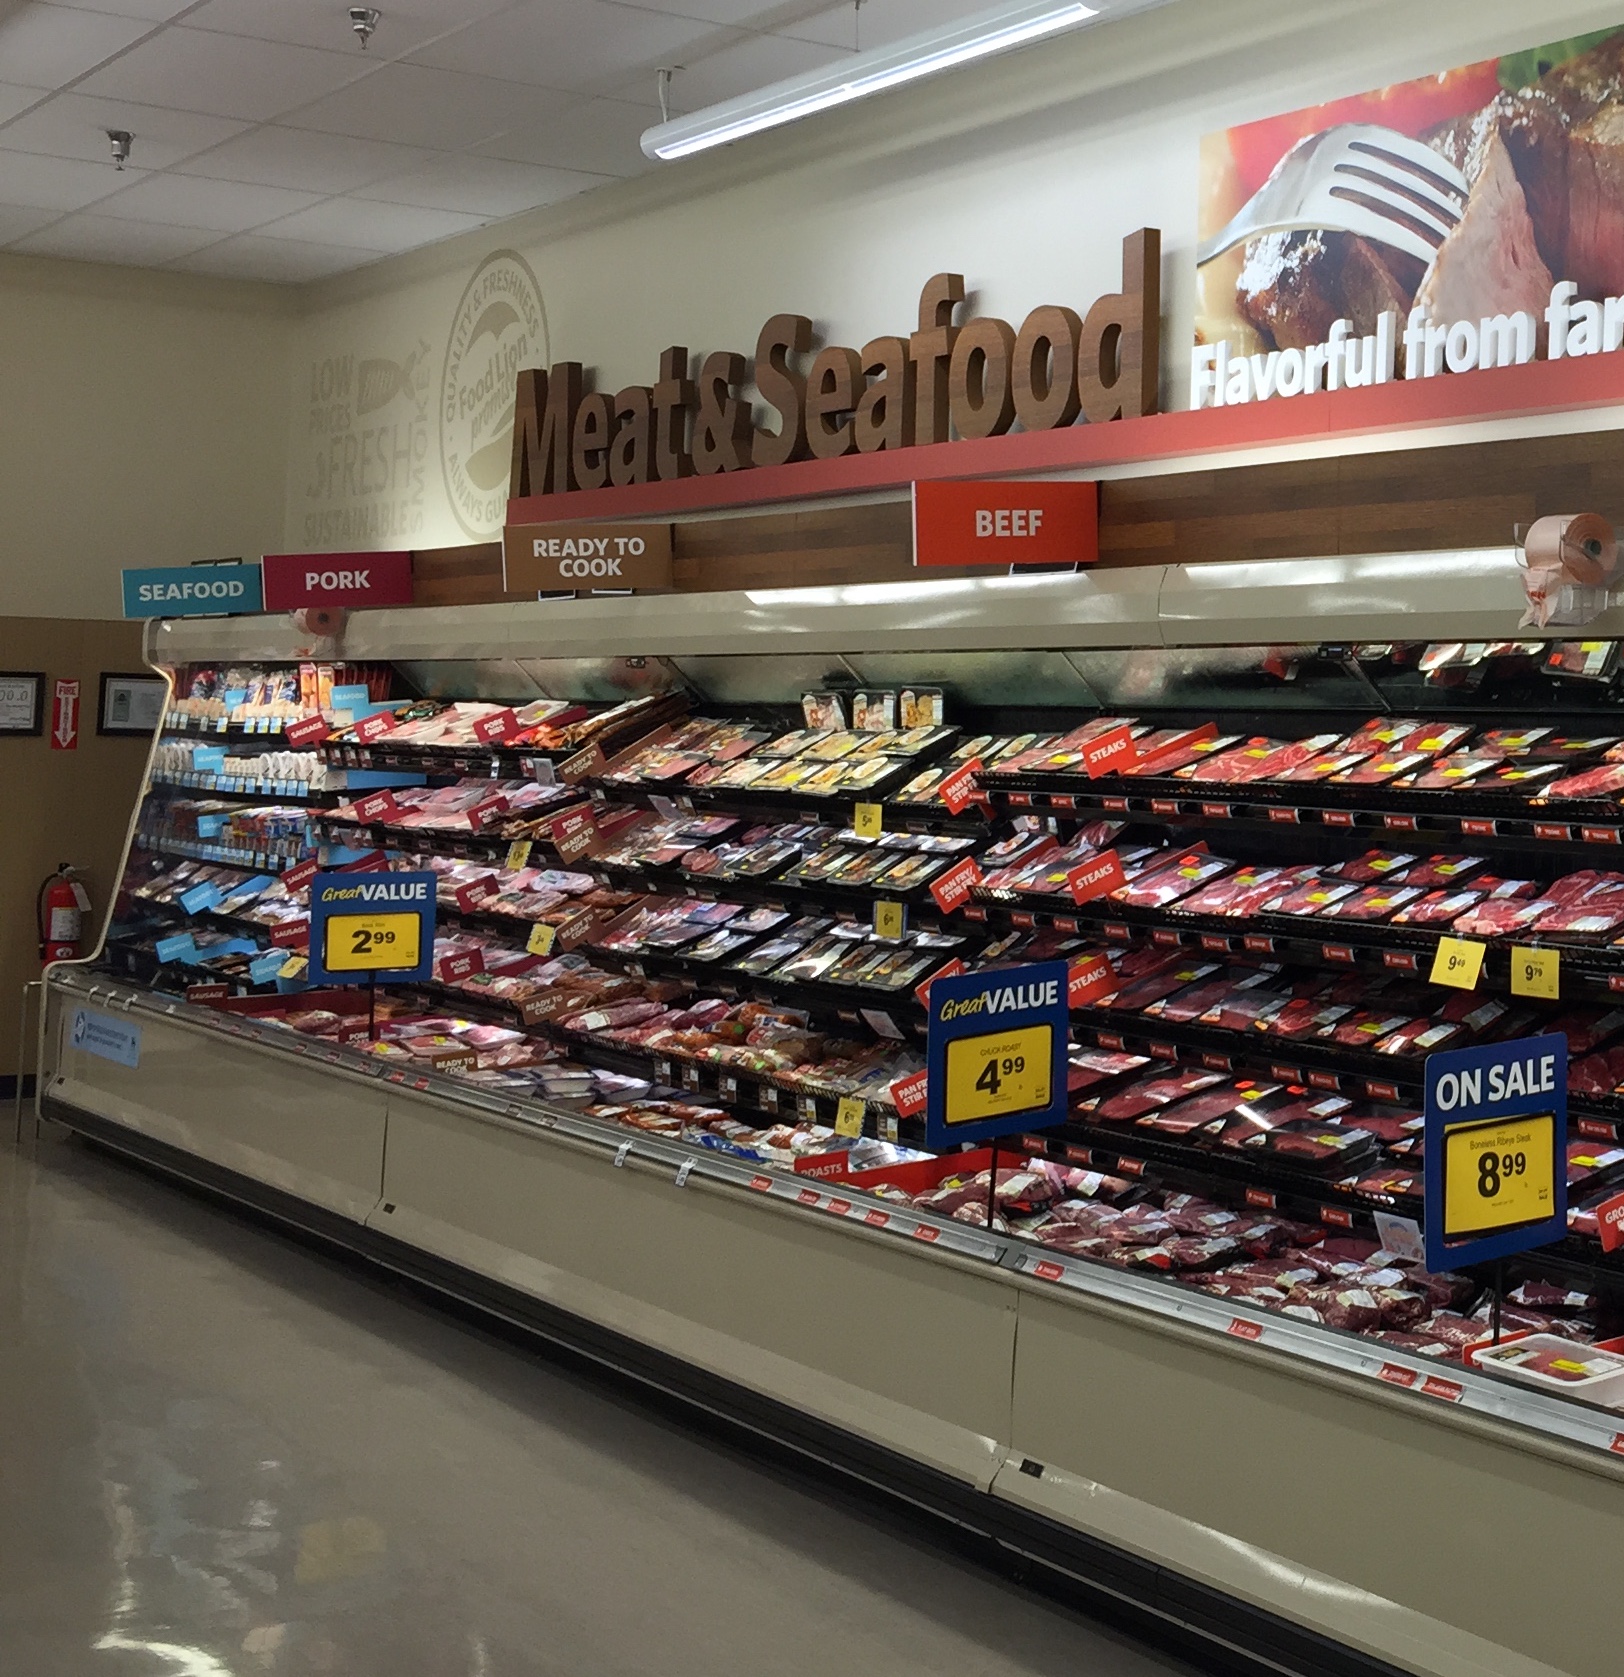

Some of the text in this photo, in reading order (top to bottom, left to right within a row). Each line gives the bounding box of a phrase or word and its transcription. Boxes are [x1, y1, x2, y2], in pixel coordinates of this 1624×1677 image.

[445, 306, 474, 423] QUALITY
[482, 269, 539, 339] FRESHNESS
[510, 345, 702, 499] Meat
[752, 227, 1161, 467] Seafood
[1191, 310, 1396, 410] Flavorful
[1403, 304, 1537, 379] from
[459, 333, 528, 419] Food Lion
[449, 454, 483, 522] ALWAYS
[975, 509, 1043, 537] BEEF
[533, 537, 645, 557] READY TO
[559, 558, 622, 578] COOK
[305, 570, 371, 591] PORK
[138, 581, 244, 602] SEAFOOD
[290, 721, 323, 740] SAUSAGE
[483, 717, 505, 731] PORK
[1088, 738, 1128, 763] STEAKS
[564, 755, 587, 775] READY
[560, 832, 583, 852] READY
[938, 878, 956, 896] PAN
[1075, 863, 1115, 891] STEAKS
[322, 883, 428, 901] Great VALUE
[944, 885, 962, 902] STIR
[274, 925, 308, 939] SAUSAGE
[561, 920, 583, 940] READY
[450, 956, 470, 969] PORK
[1069, 966, 1107, 992] STEAKS
[525, 994, 563, 1012] READY TO
[534, 1004, 556, 1016] COOK
[940, 991, 988, 1022] Great
[985, 980, 1060, 1015] VALUE
[436, 1056, 475, 1069] READY TO
[898, 1082, 917, 1099] PAN
[1436, 1055, 1555, 1111] ON SALE
[902, 1093, 923, 1107] STIR
